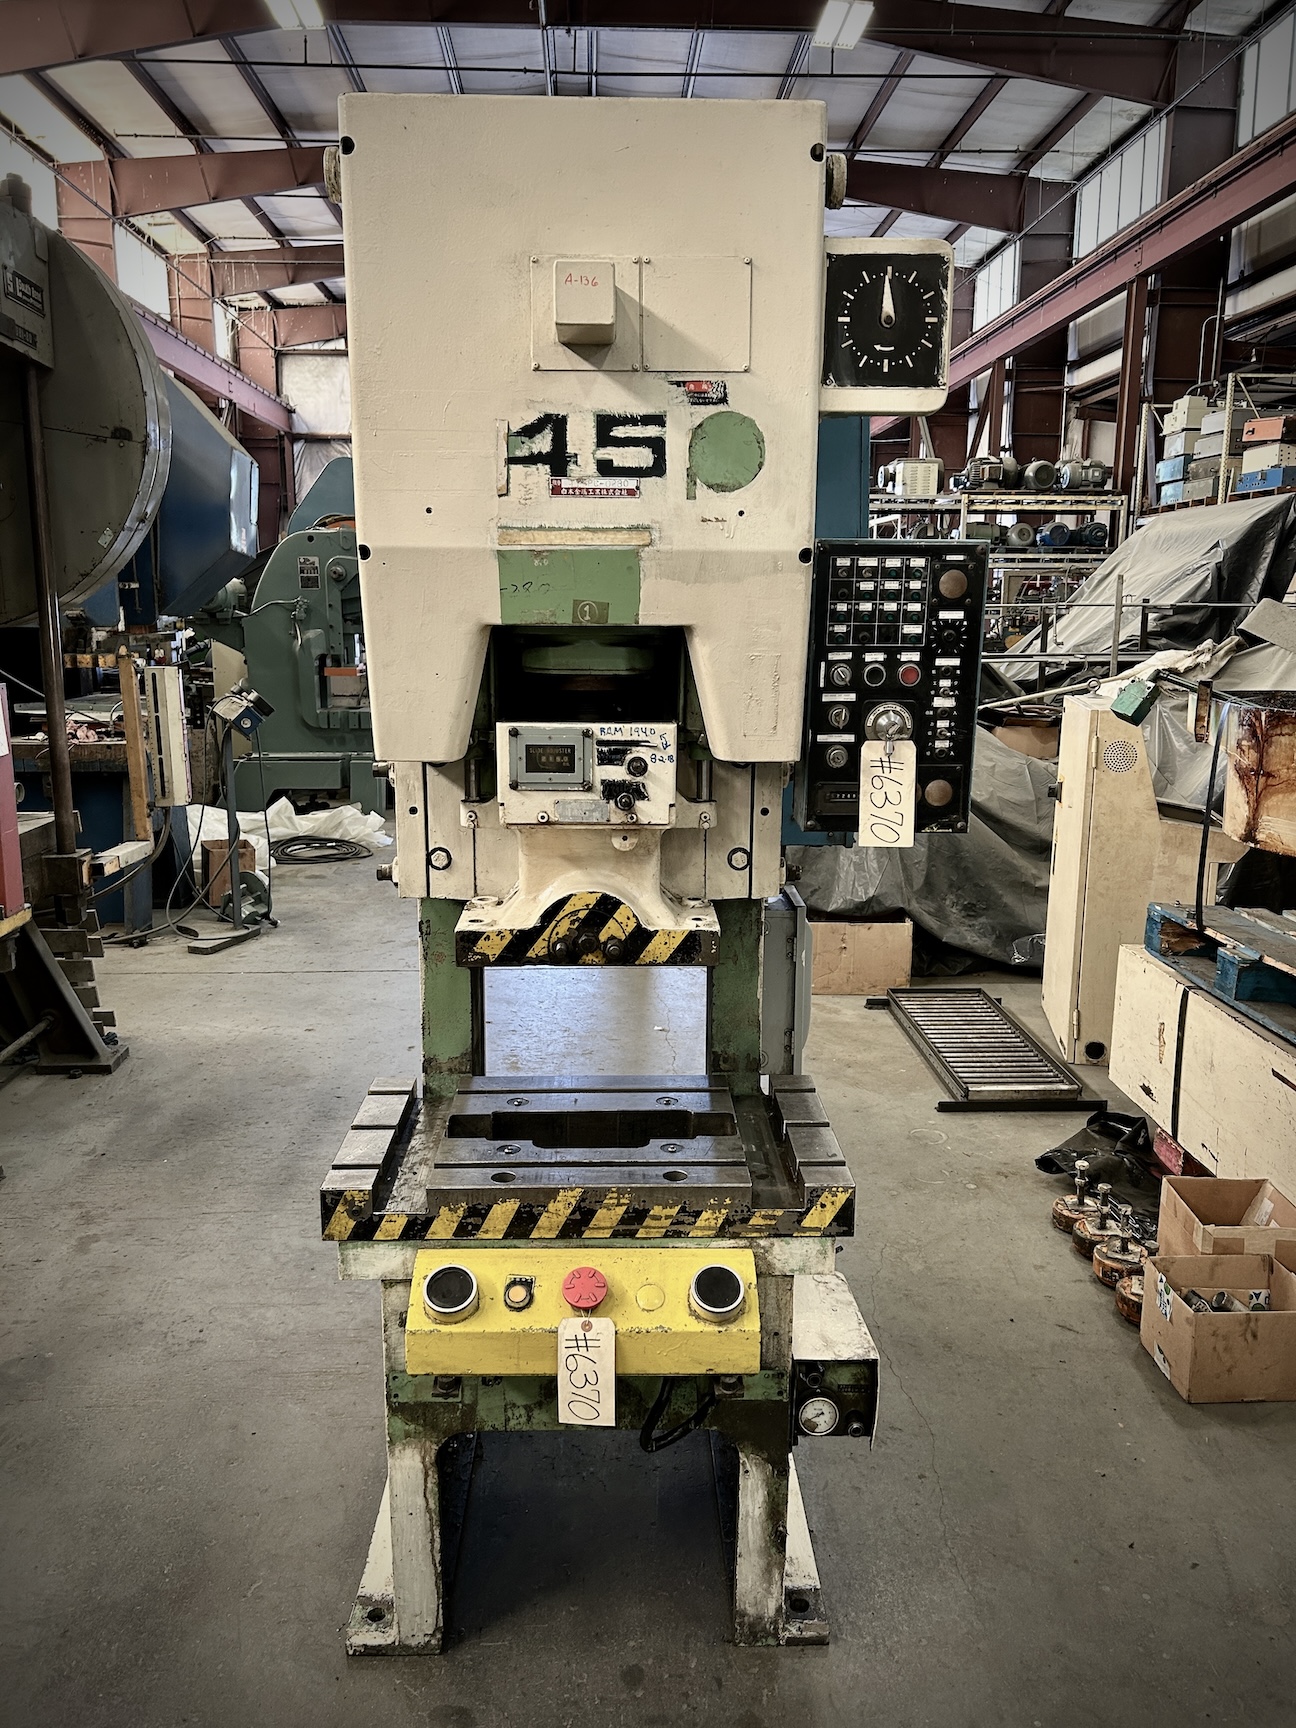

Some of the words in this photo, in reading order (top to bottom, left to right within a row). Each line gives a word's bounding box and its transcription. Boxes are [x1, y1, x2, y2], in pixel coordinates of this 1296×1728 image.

[564, 272, 599, 287] A-136
[599, 726, 624, 737] RAM
[629, 727, 656, 737] 1940
[869, 755, 905, 844] #6370
[564, 1332, 601, 1421] #6370
